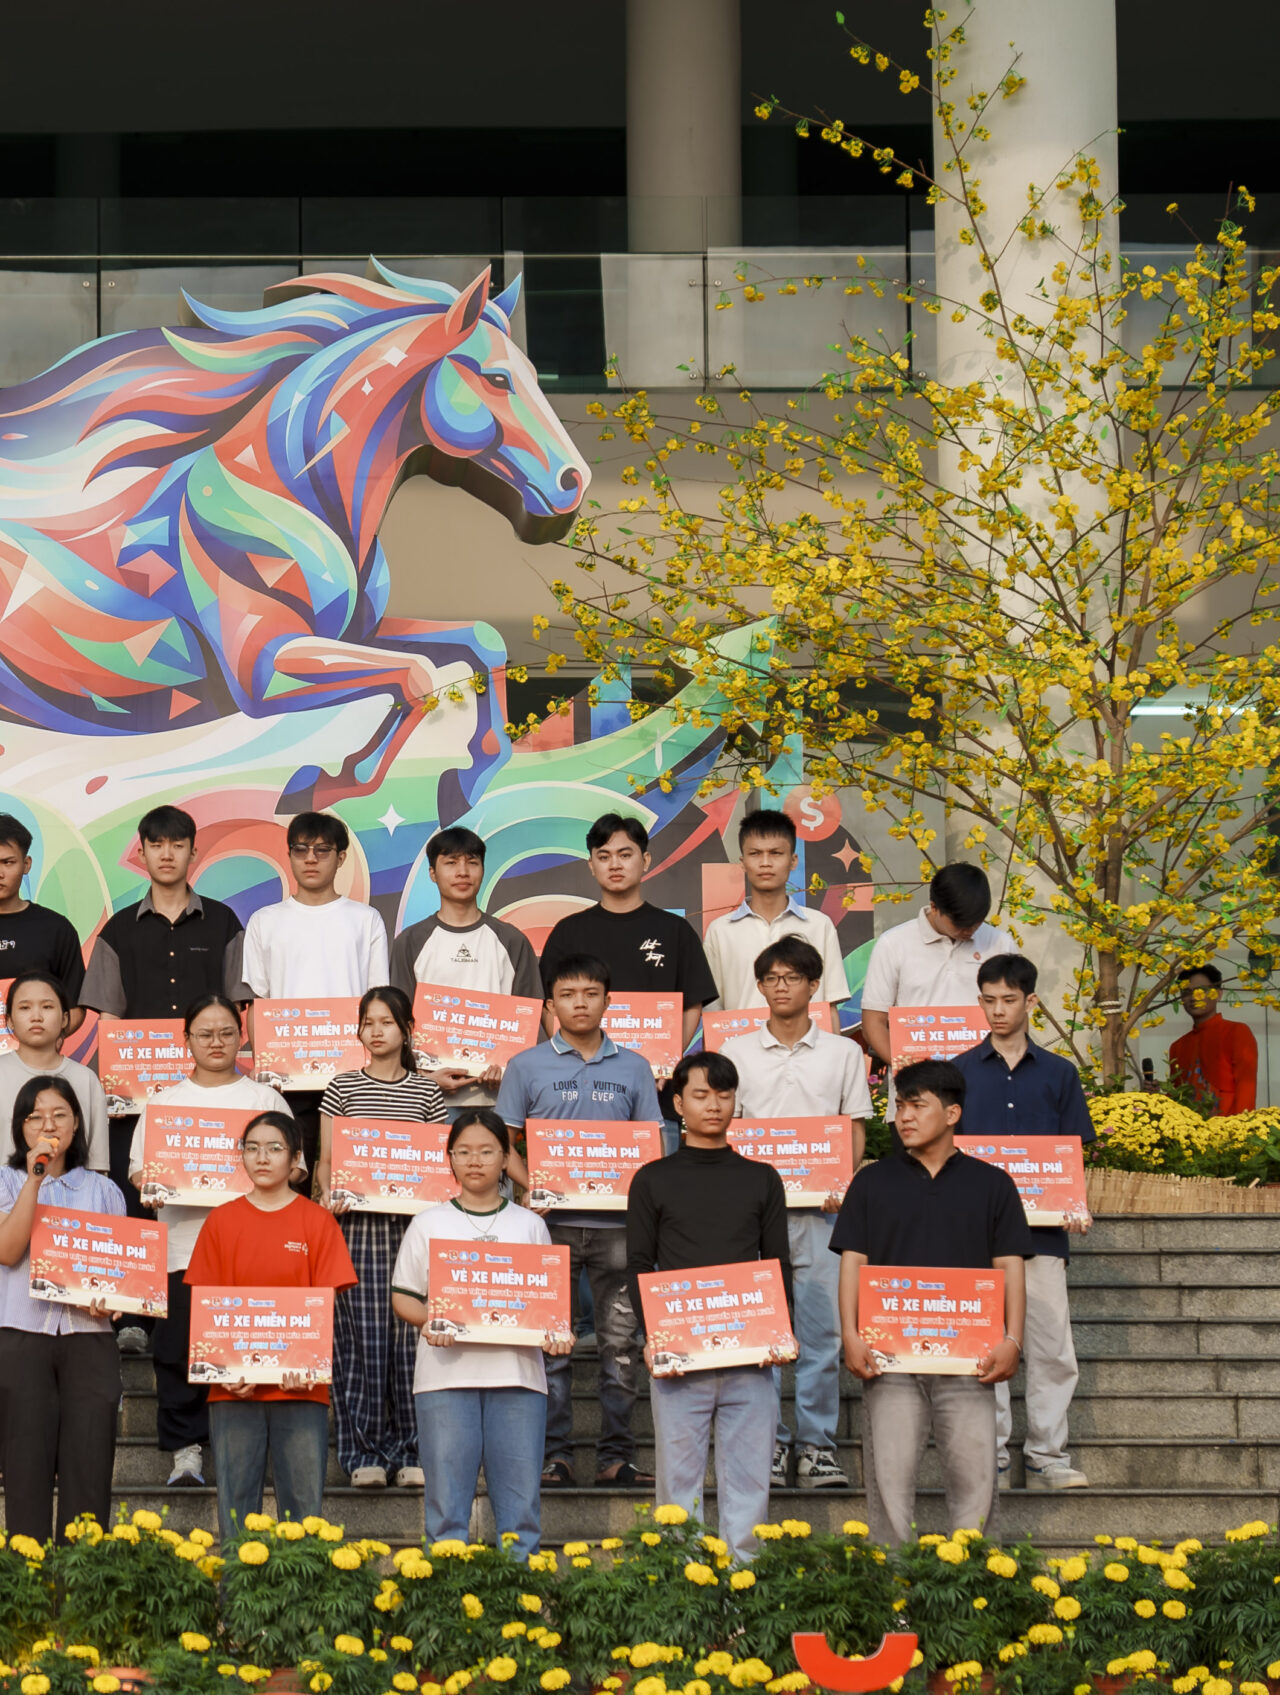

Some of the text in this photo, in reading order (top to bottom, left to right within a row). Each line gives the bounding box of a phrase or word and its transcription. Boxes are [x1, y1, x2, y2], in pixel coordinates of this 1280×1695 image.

[433, 1009, 447, 1021] VÉ
[449, 1012, 465, 1024] XE
[499, 1019, 519, 1032] PHÍ
[643, 1016, 662, 1028] PHÍ
[274, 1023, 289, 1036] VÉ
[293, 1025, 308, 1036] XE
[343, 1024, 360, 1035] PH
[910, 1029, 925, 1041] VÉ
[928, 1030, 944, 1040] XE
[118, 1045, 133, 1059] VÉ
[136, 1047, 151, 1058] XE
[553, 1080, 627, 1094] LOUIS VUITTON
[562, 1090, 615, 1102] FOR EVER
[165, 1132, 180, 1146] VÉ
[184, 1135, 200, 1147] XE
[352, 1143, 368, 1156] VÉ
[371, 1146, 387, 1158] XE
[424, 1149, 443, 1162] PHÍ
[548, 1143, 563, 1156] VÉ
[567, 1146, 583, 1156] XE
[620, 1145, 639, 1158] PHÍ
[737, 1142, 753, 1156] VÉ
[757, 1144, 773, 1155] XE
[810, 1140, 830, 1153] PHÍ
[1042, 1160, 1062, 1173] PHÍ
[52, 1233, 68, 1246] VÉ
[72, 1237, 88, 1250] XE
[126, 1245, 146, 1259] PHÍ
[451, 1267, 467, 1281] VÉ
[471, 1270, 488, 1283] XE
[527, 1272, 547, 1286] PHÍ
[665, 1297, 682, 1313] VÉ
[685, 1298, 703, 1311] XE
[741, 1288, 763, 1305] PHÍ
[881, 1295, 898, 1310] VÉ
[902, 1298, 919, 1311] XE
[960, 1298, 980, 1313] PHÍ
[213, 1312, 229, 1326] VÉ
[233, 1315, 250, 1326] XE
[289, 1313, 310, 1327] PHÍ
